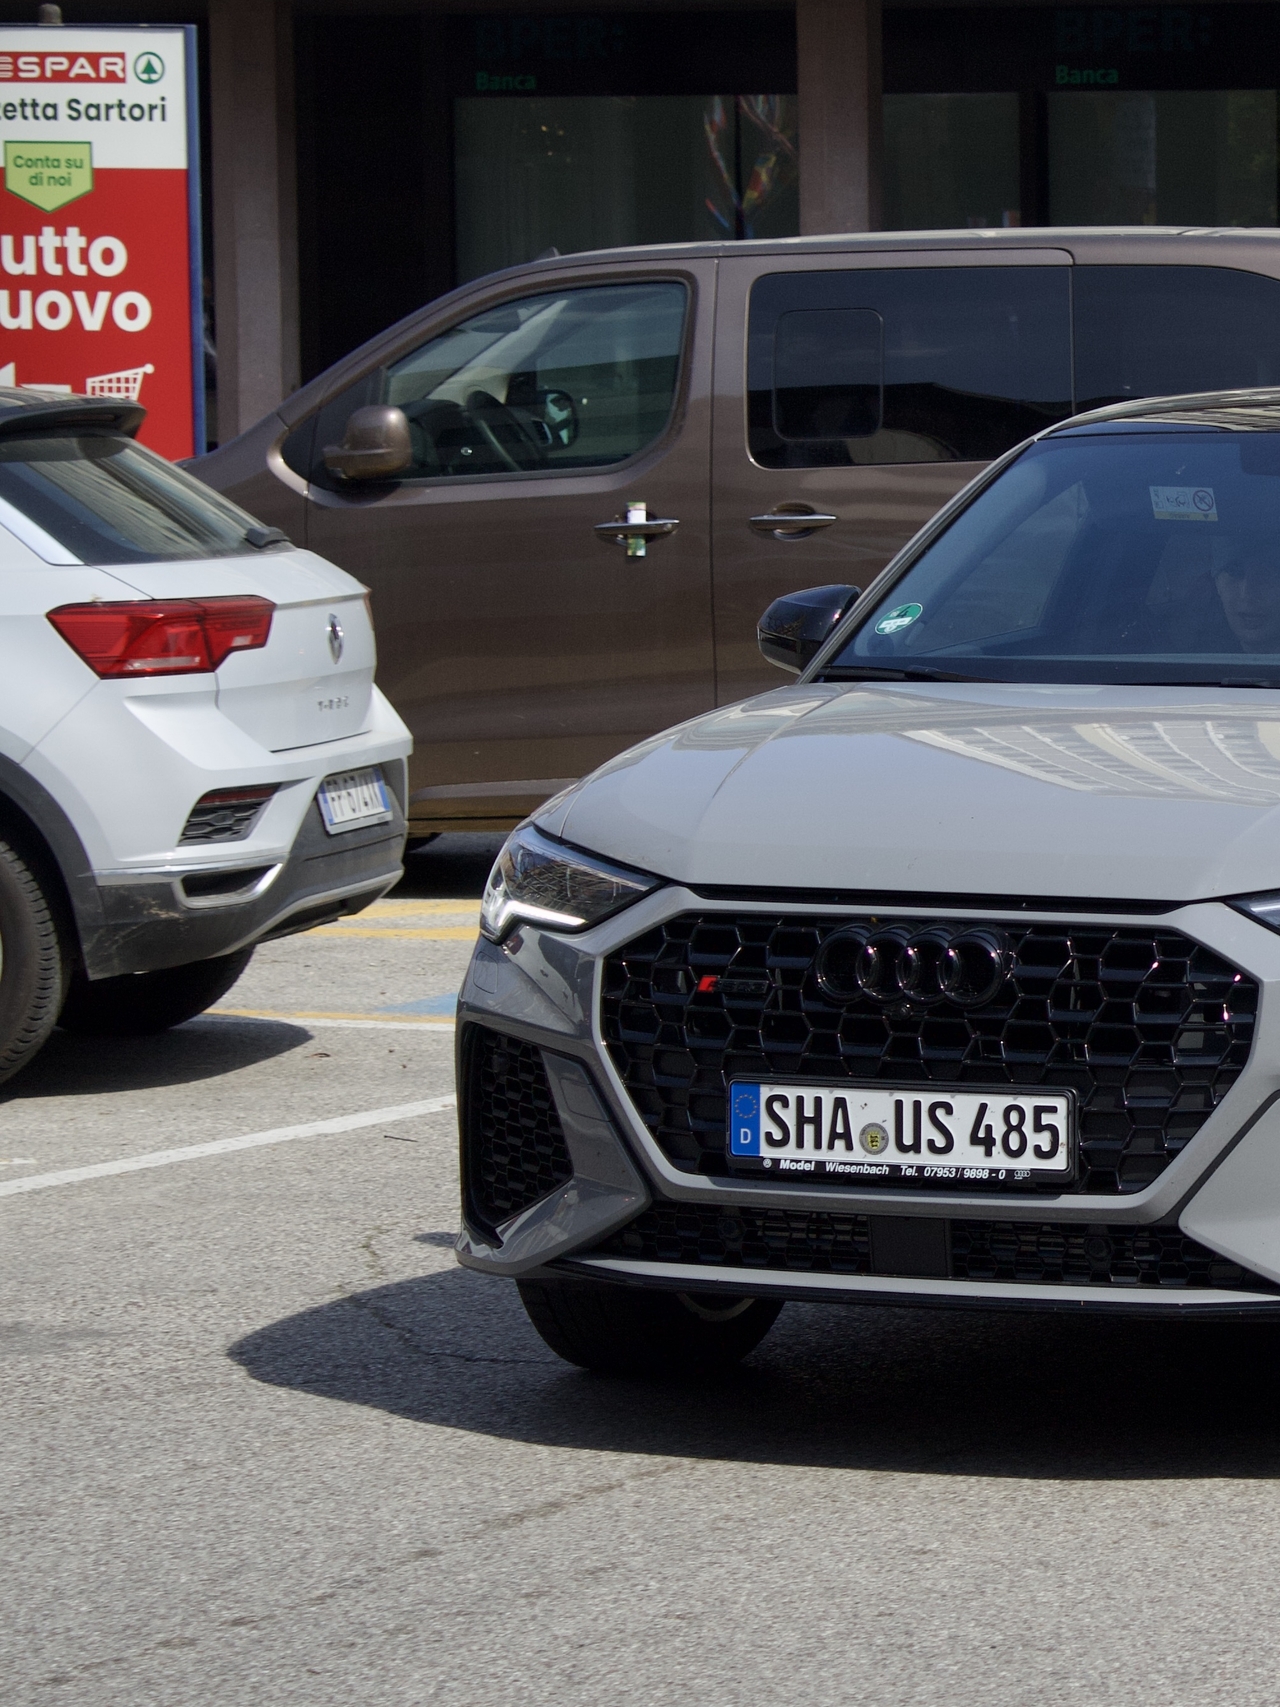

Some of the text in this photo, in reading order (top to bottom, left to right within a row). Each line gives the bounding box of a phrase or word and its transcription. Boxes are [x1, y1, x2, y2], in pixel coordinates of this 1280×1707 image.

[475, 71, 537, 91] Banca
[1055, 65, 1119, 84] Banca
[0, 97, 166, 121] etta Sartori
[13, 155, 83, 169] Conta su
[29, 172, 72, 186] di noi
[740, 1128, 751, 1144] D
[765, 1094, 1060, 1160] SHA US 485
[780, 1159, 815, 1171] Model
[825, 1162, 889, 1176] Wiesenbach
[900, 1165, 918, 1177] Tel.
